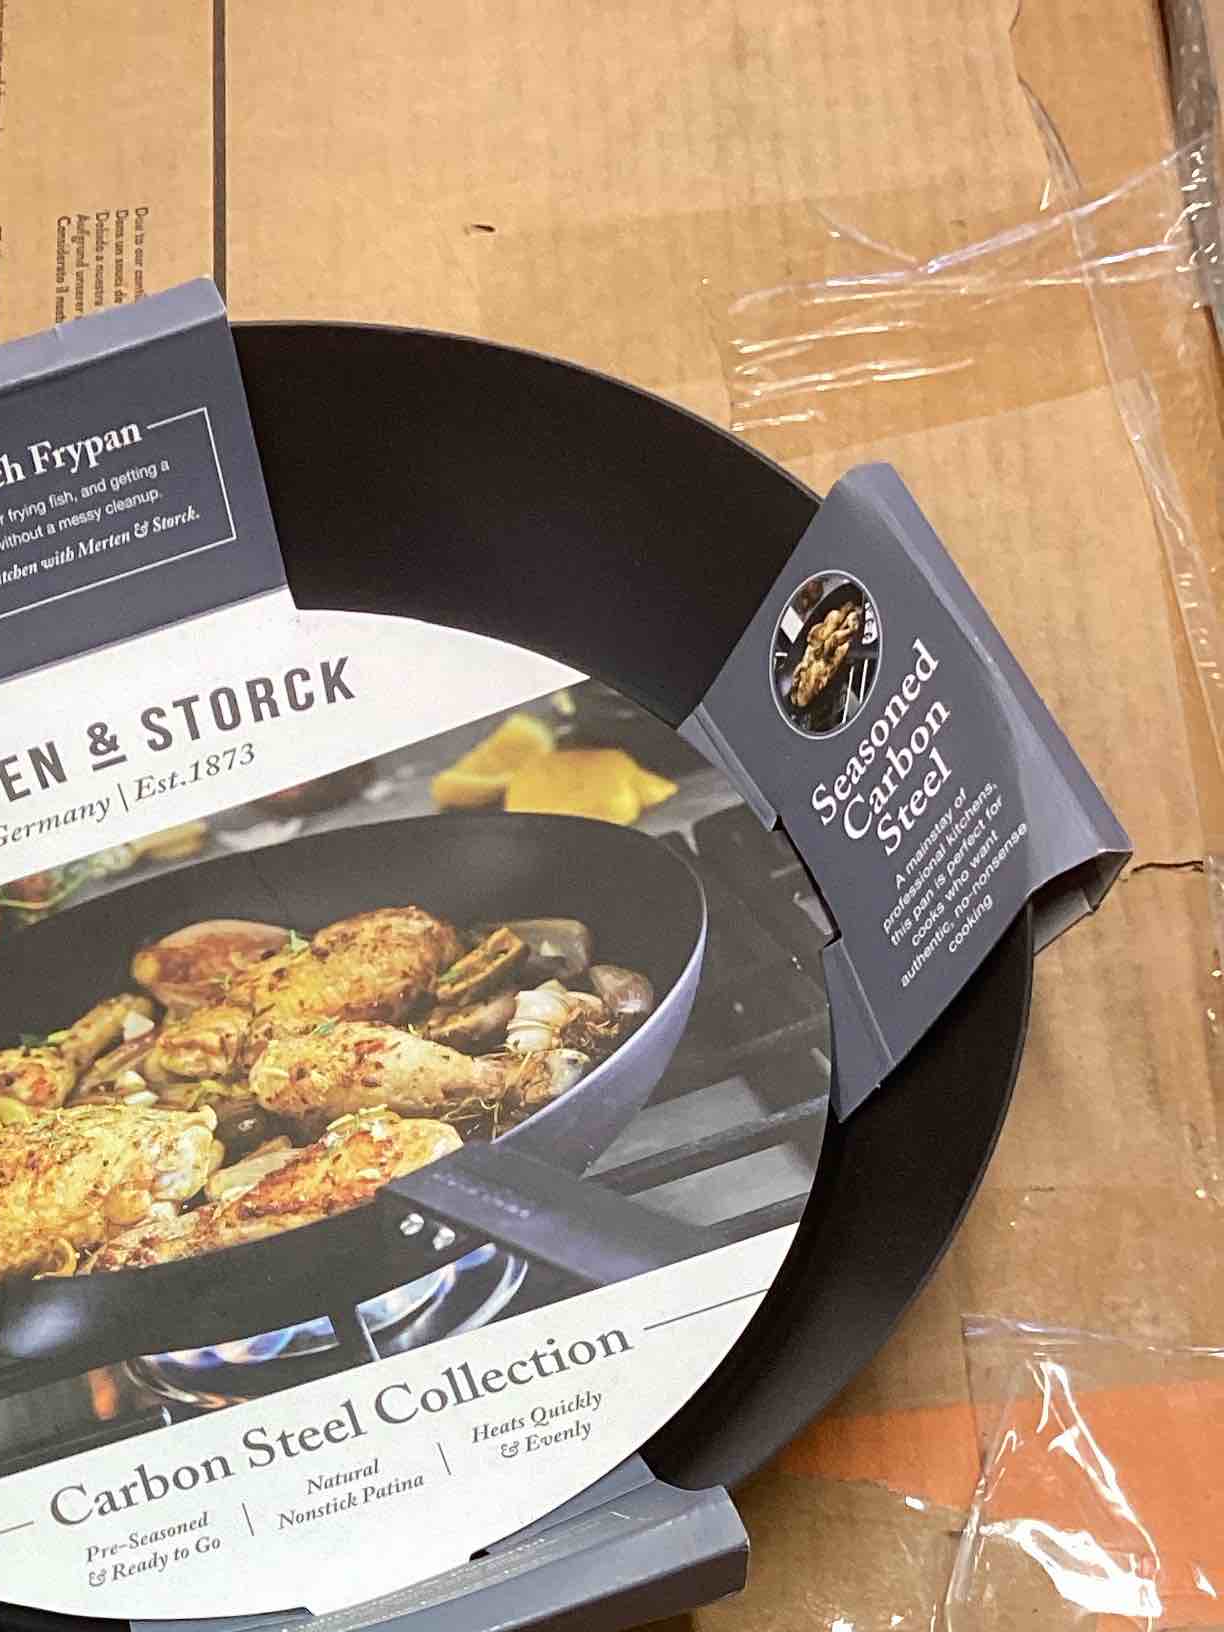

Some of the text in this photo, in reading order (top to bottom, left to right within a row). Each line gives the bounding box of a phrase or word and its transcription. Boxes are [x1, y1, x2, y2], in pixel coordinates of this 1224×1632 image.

[27, 423, 142, 475] Frypan
[7, 501, 47, 523] frying
[48, 491, 78, 509] fish,
[81, 478, 107, 498] and
[110, 464, 158, 491] getting
[160, 460, 170, 472] a
[46, 523, 56, 535] a
[58, 507, 102, 531] messy
[105, 489, 163, 515] cleanup.
[40, 546, 74, 569] with
[78, 531, 130, 558] Merten
[134, 520, 149, 538] &
[152, 505, 200, 532] Storck.
[86, 722, 128, 772] &
[140, 656, 356, 752] STORCK
[812, 638, 939, 826] Seasoned
[844, 701, 951, 839] Carbon
[877, 746, 952, 856] Steel
[883, 783, 998, 935] professional kitchens,
[891, 795, 1002, 946] this pan is perfect for
[896, 787, 966, 890] A mainstay of
[901, 823, 1028, 987] authentic, no-nonsense
[912, 829, 998, 946] cooks who want
[948, 894, 993, 953] cooking
[50, 1330, 633, 1526] Carbon Steel Collection
[472, 1391, 602, 1443] Heats Quickly
[500, 1420, 591, 1459] & Evenly
[278, 1475, 424, 1530] Nonstick Patina
[307, 1458, 379, 1495] Natural
[87, 1511, 208, 1563] Pre-Seasoned
[88, 1536, 221, 1588] & Ready to Go
